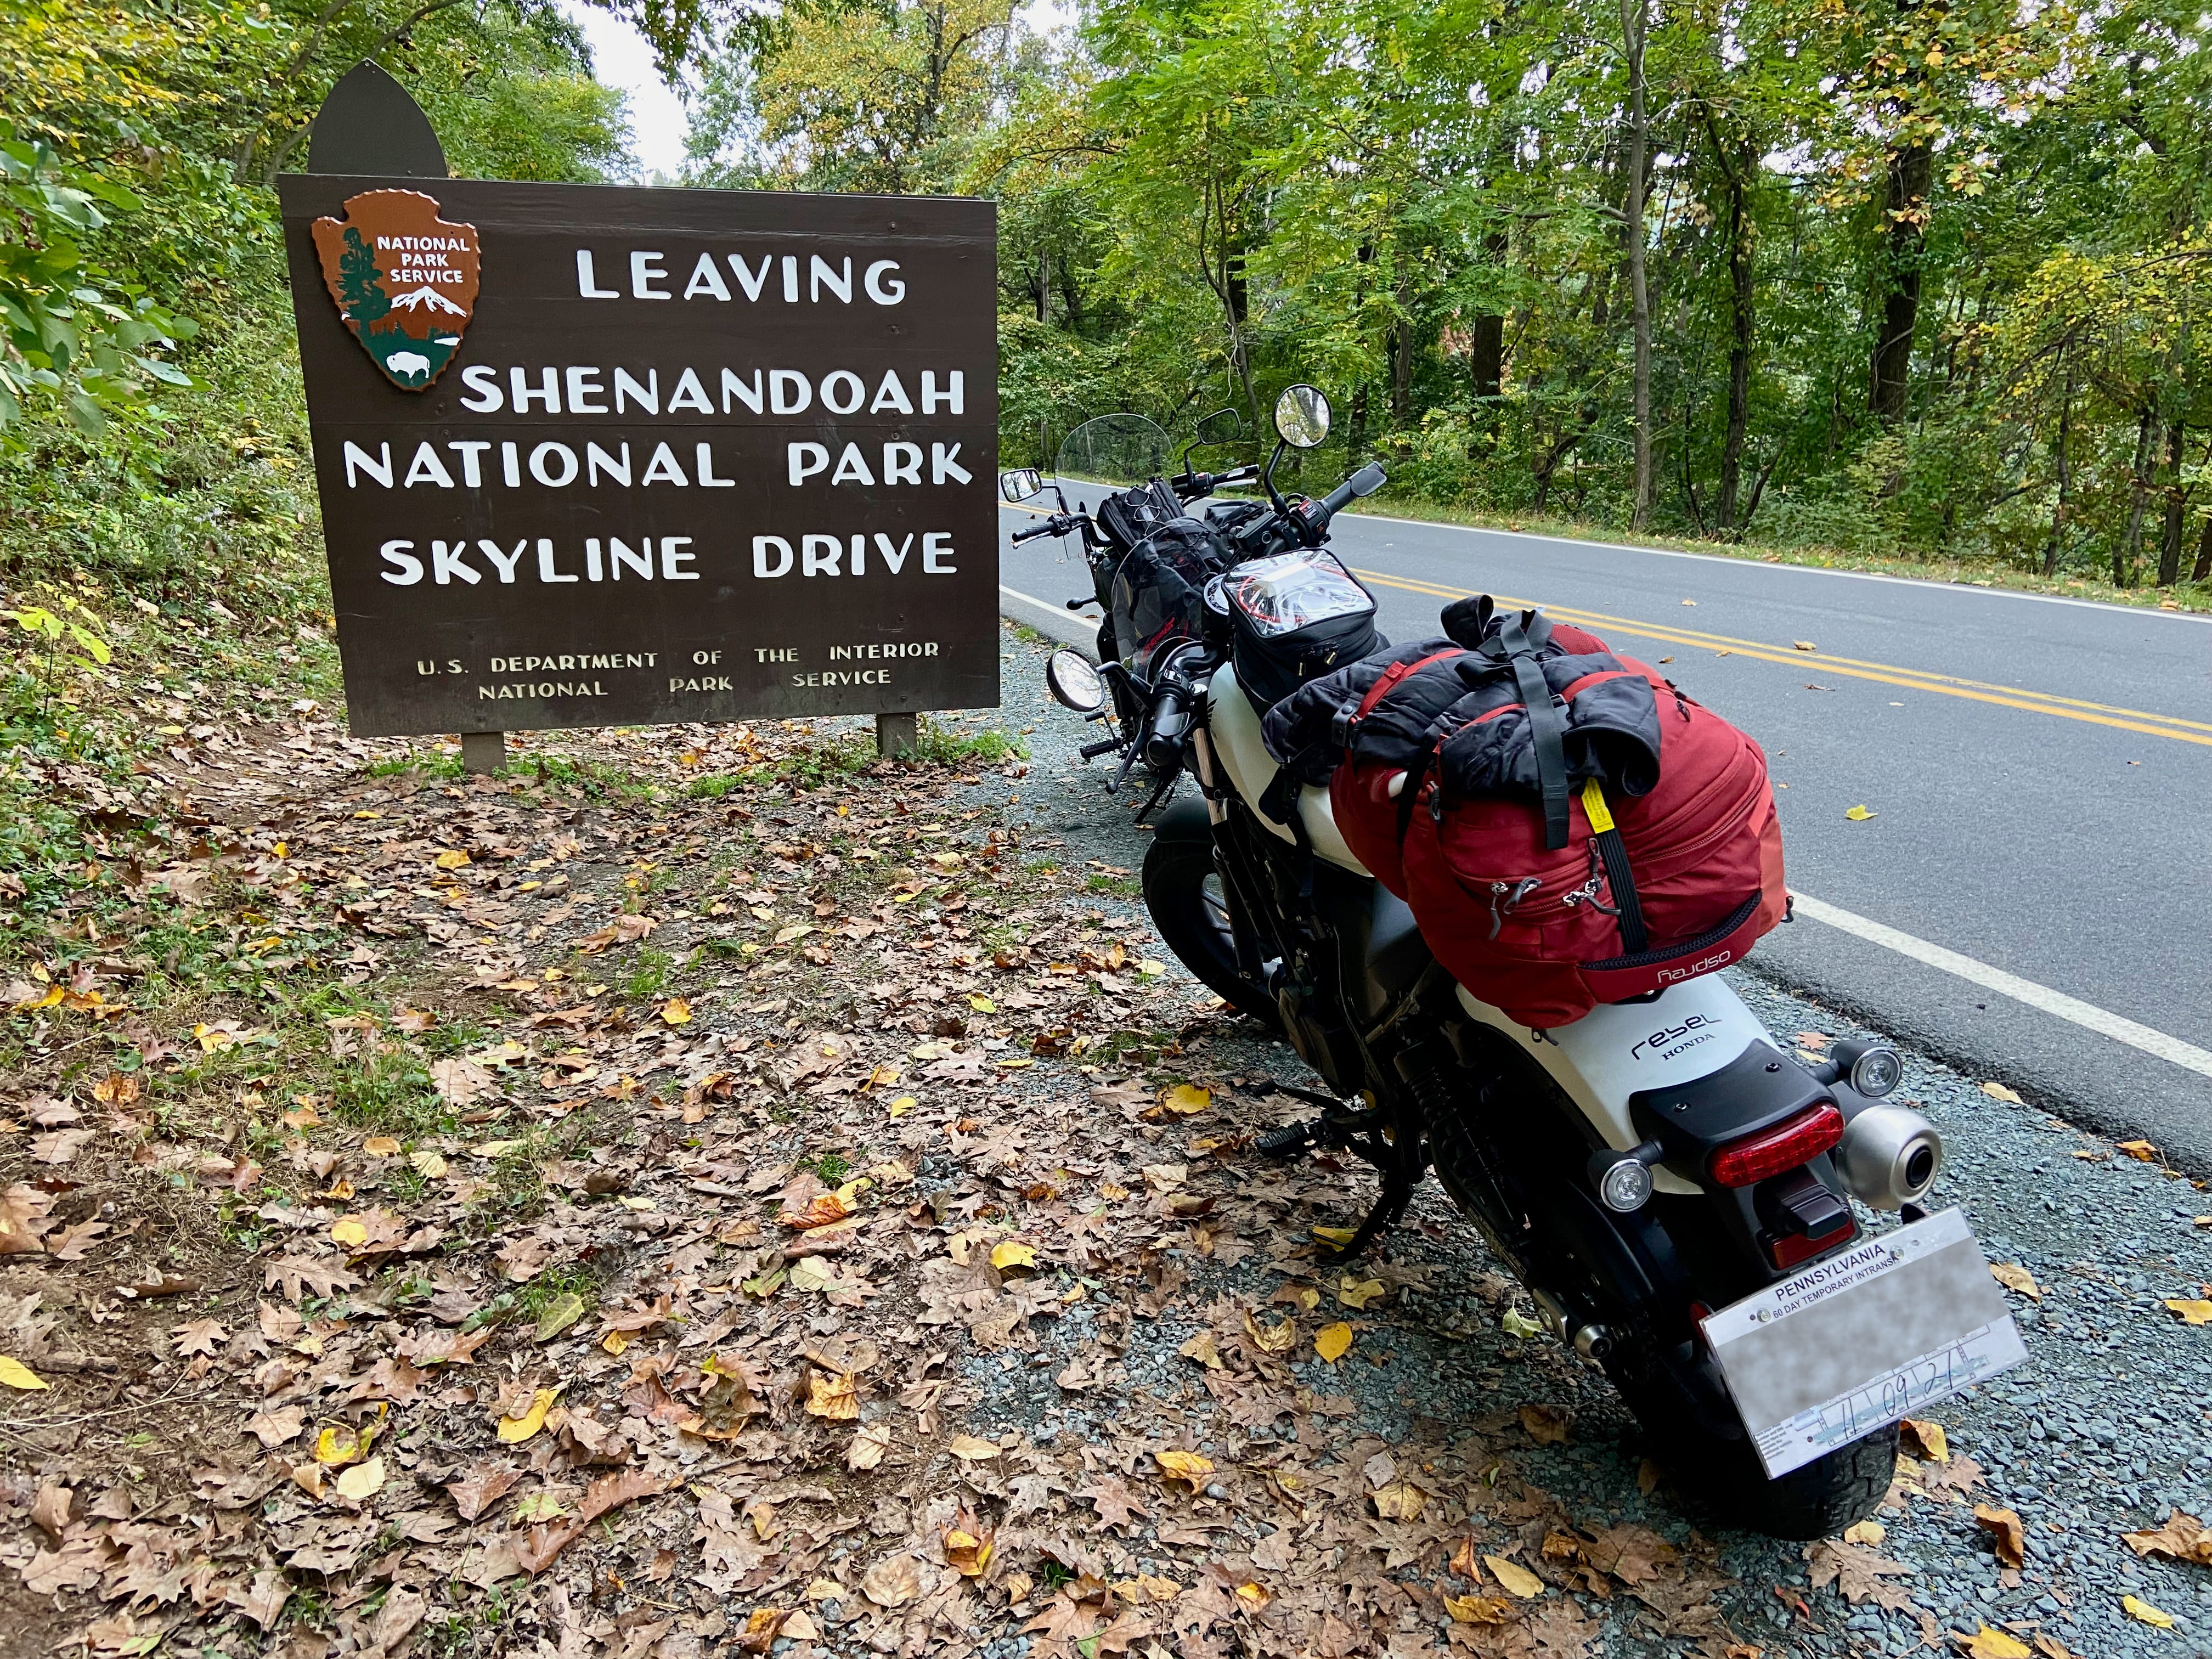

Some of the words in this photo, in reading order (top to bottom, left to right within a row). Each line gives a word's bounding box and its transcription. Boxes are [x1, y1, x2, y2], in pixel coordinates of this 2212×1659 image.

[377, 236, 470, 251] NATIONAL
[402, 253, 448, 267] PARK
[390, 269, 463, 283] SERVICE
[577, 250, 905, 305] LEAVING
[460, 366, 963, 415] SHENANDOAH
[344, 441, 735, 488] NATIONAL
[788, 442, 972, 486] PARK
[381, 537, 699, 585] SKYLINE
[753, 532, 957, 577] DRIVE
[417, 659, 469, 675] U.S.
[491, 653, 658, 672] DEPARTMENT
[693, 651, 721, 664] OF
[754, 648, 799, 662] THE
[830, 642, 938, 659] INTERIOR
[479, 681, 608, 699] NATIONAL
[670, 676, 733, 692] PARK
[791, 669, 891, 686] SERVICE
[1657, 950, 1731, 983] osprey
[1662, 1034, 1716, 1061] HONDA
[1775, 1244, 1886, 1302] PENNSYLVANIA
[1773, 1308, 1784, 1319] 60
[1784, 1299, 1802, 1314] DAY
[1801, 1274, 1854, 1305] TEMPORARY
[1883, 1374, 1910, 1417] 09
[1924, 1350, 1953, 1395] 21
